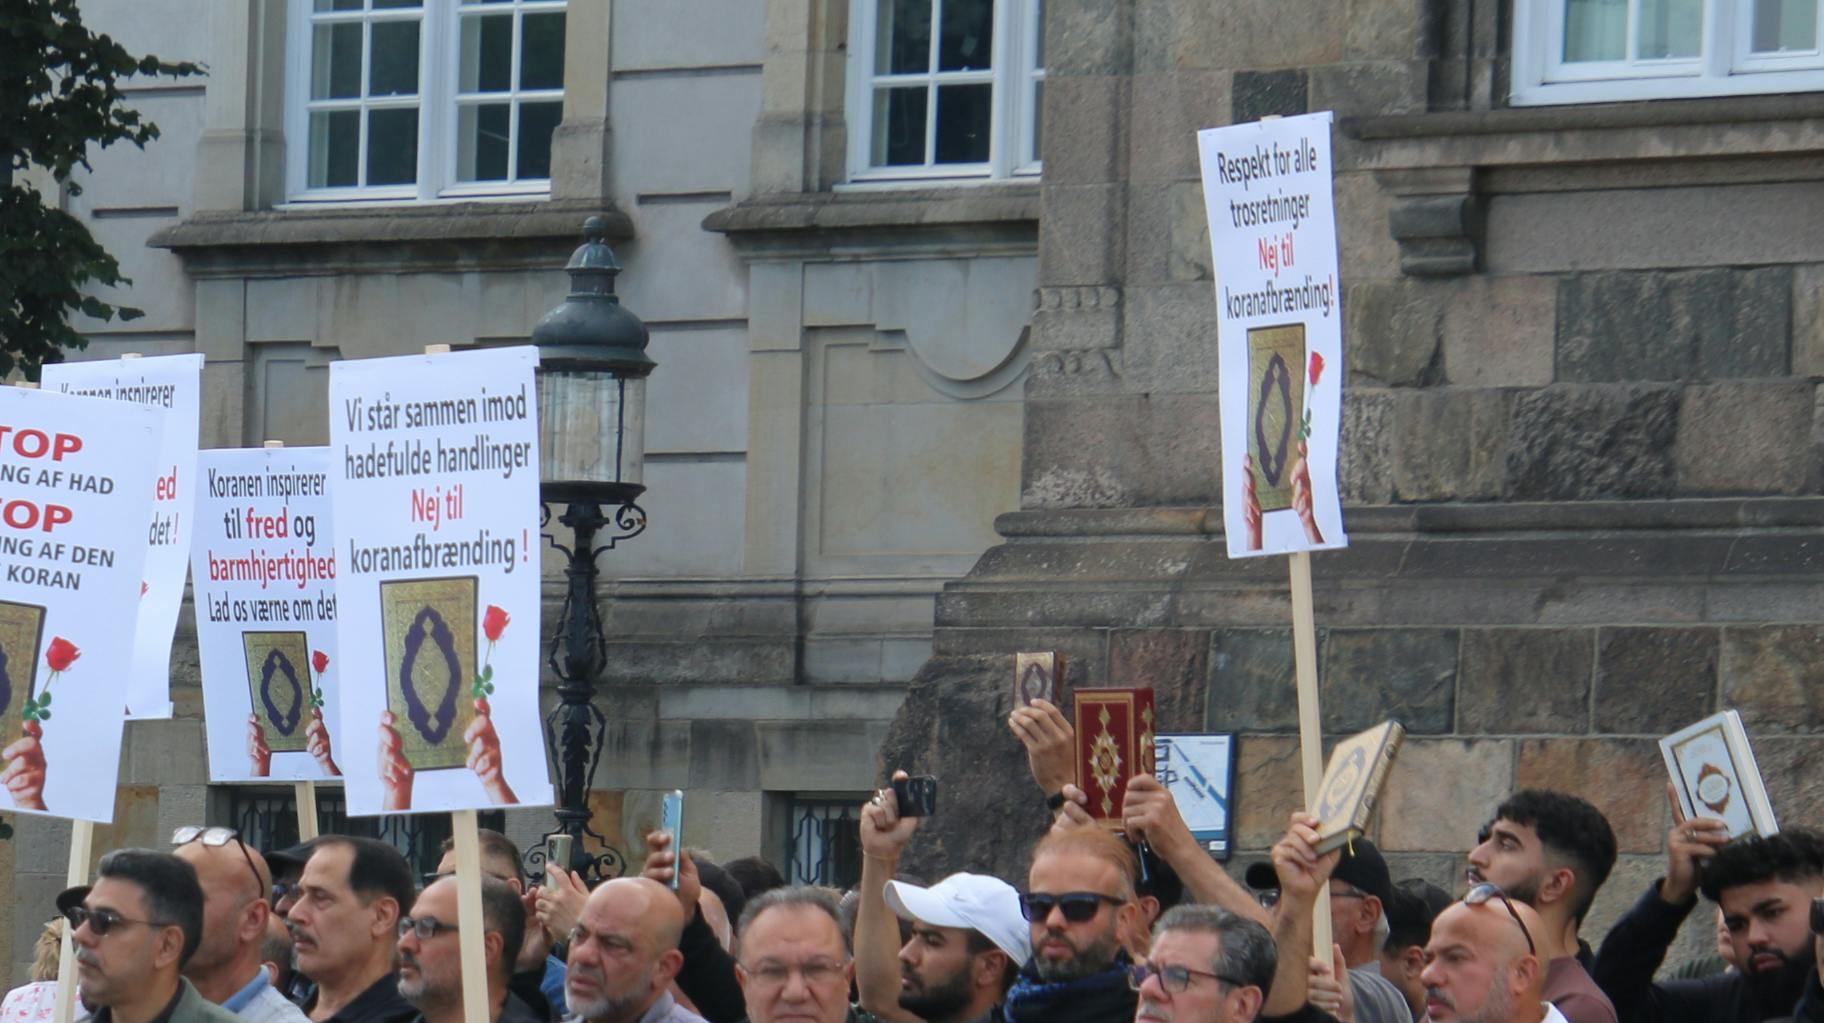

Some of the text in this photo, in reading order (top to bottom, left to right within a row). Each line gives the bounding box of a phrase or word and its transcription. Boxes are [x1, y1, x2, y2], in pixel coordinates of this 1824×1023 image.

[1217, 137, 1317, 191] Respekt for alle
[1230, 188, 1310, 230] trosretninger
[1258, 232, 1294, 278] Nej til
[346, 383, 527, 432] Vi står sammen imod
[345, 434, 531, 479] hadefulde handlinger
[36, 469, 63, 488] AF
[69, 473, 114, 495] HAD
[208, 468, 263, 498] Koranen
[266, 465, 326, 505] inspirerer
[224, 507, 315, 547] til fred og
[412, 484, 463, 531] Nej til
[149, 512, 171, 546] det
[38, 542, 65, 561] AF
[71, 546, 114, 568] DEN
[208, 548, 336, 590] barmhjertighed
[350, 528, 528, 574] koranafbrænding !
[7, 564, 80, 590] KORAN
[208, 591, 230, 622] Lad
[233, 600, 248, 622] os
[250, 600, 290, 622] værne
[293, 599, 314, 621] om
